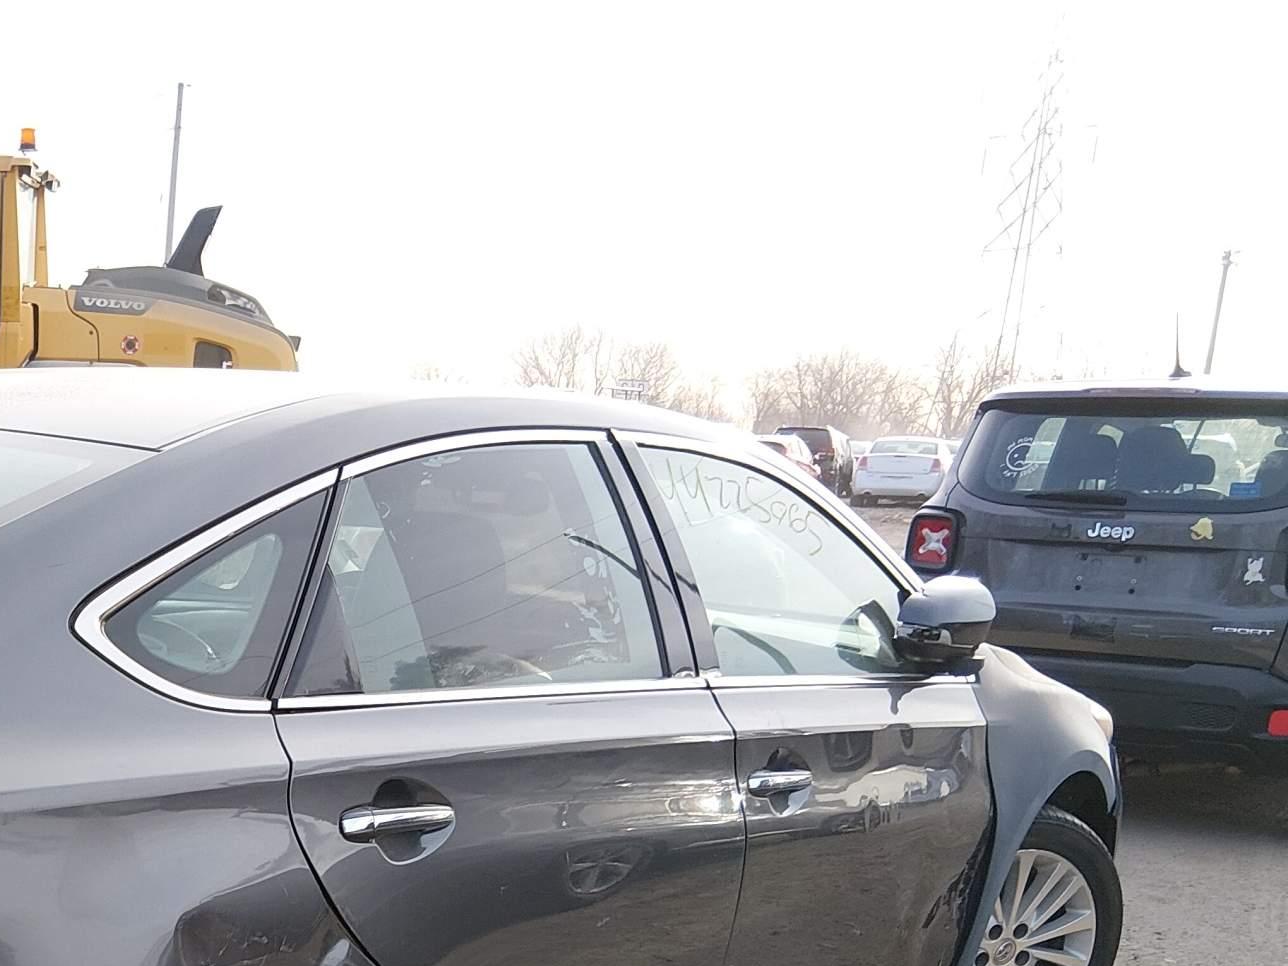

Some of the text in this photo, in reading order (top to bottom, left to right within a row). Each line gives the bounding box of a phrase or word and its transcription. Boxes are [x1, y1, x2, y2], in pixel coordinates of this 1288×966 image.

[81, 296, 145, 311] VOLVO
[1087, 522, 1135, 542] Jeep
[1212, 626, 1275, 636] SPORT
